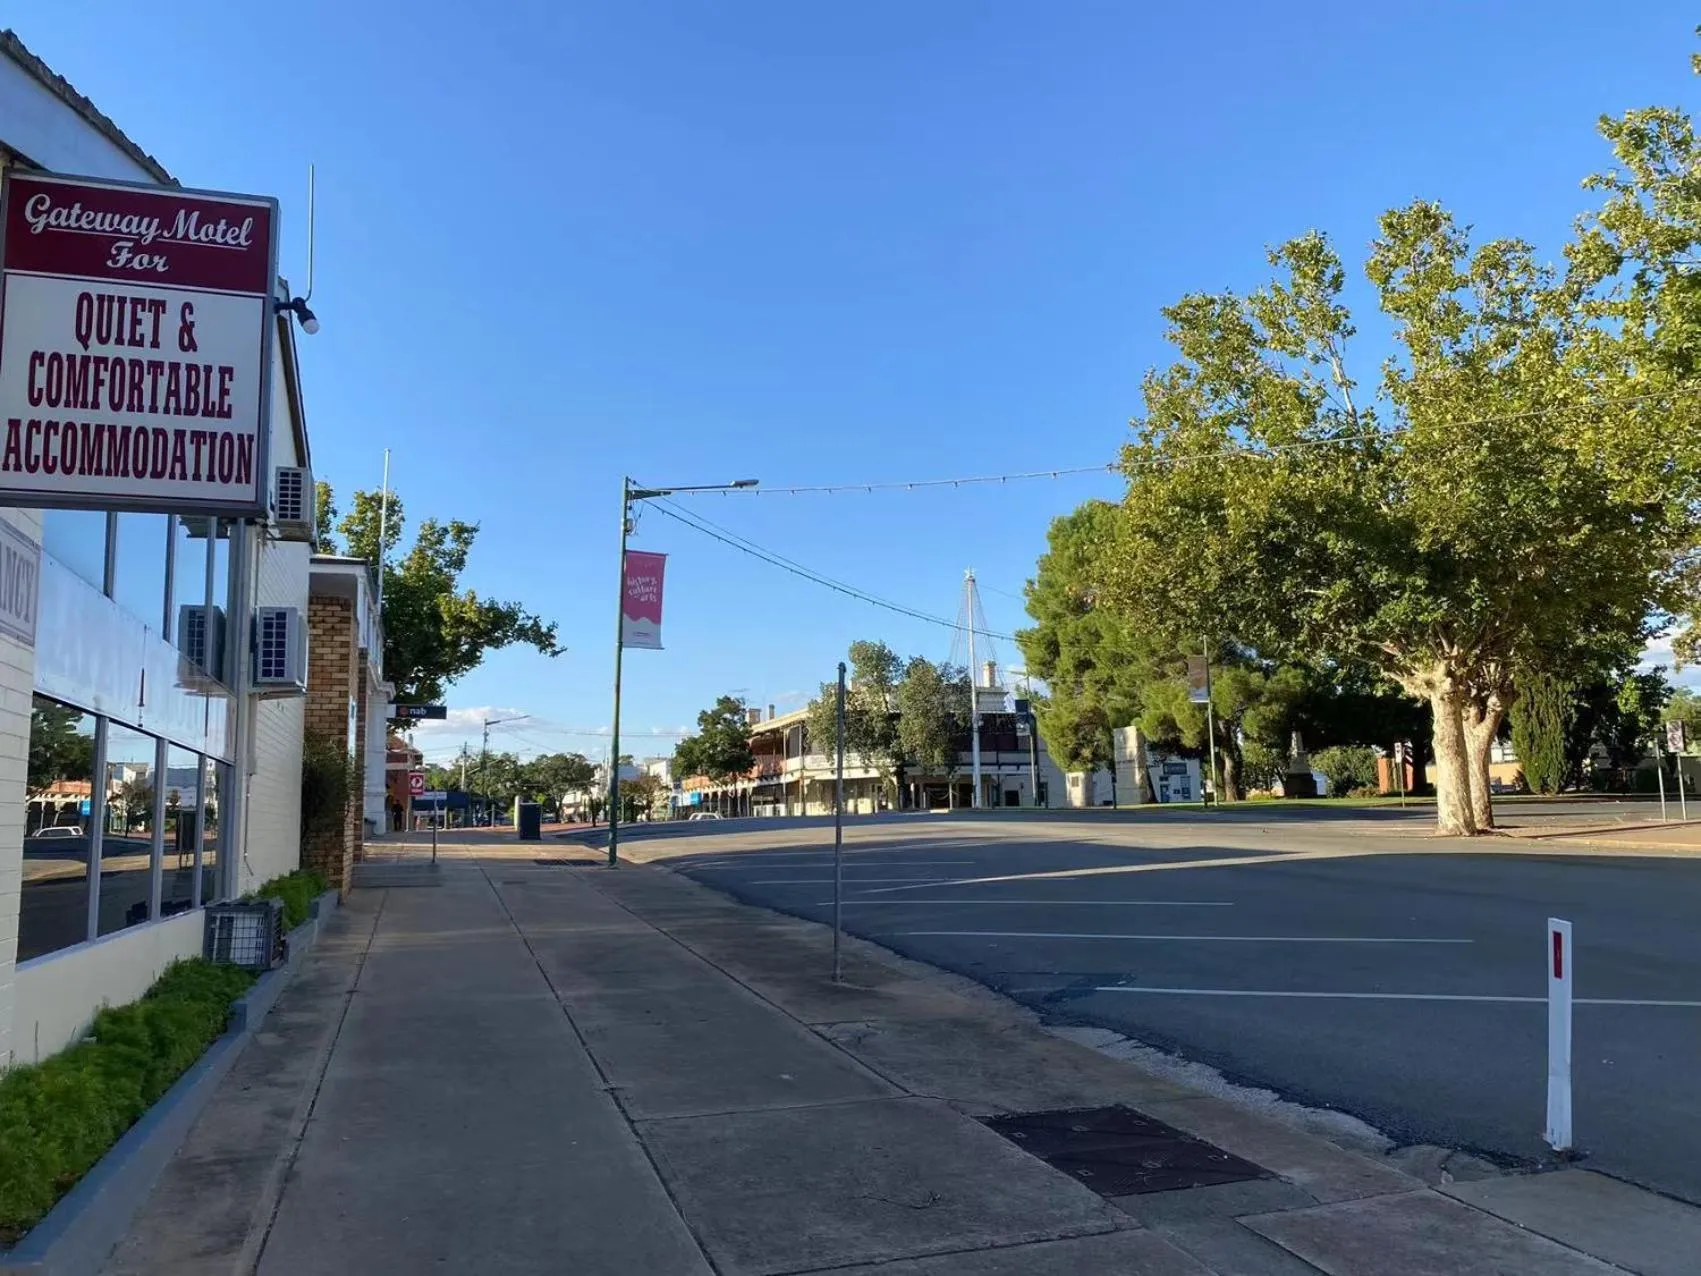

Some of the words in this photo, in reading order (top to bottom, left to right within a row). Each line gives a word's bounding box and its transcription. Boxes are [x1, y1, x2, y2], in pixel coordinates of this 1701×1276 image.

[24, 193, 161, 245] Gateway
[163, 209, 253, 247] Motel
[106, 241, 169, 272] For
[75, 291, 167, 351] QUIET
[178, 301, 198, 352] &
[27, 350, 234, 420] COMFORTABLE
[2, 418, 255, 485] ACCOMMODATION
[409, 707, 427, 715] nab
